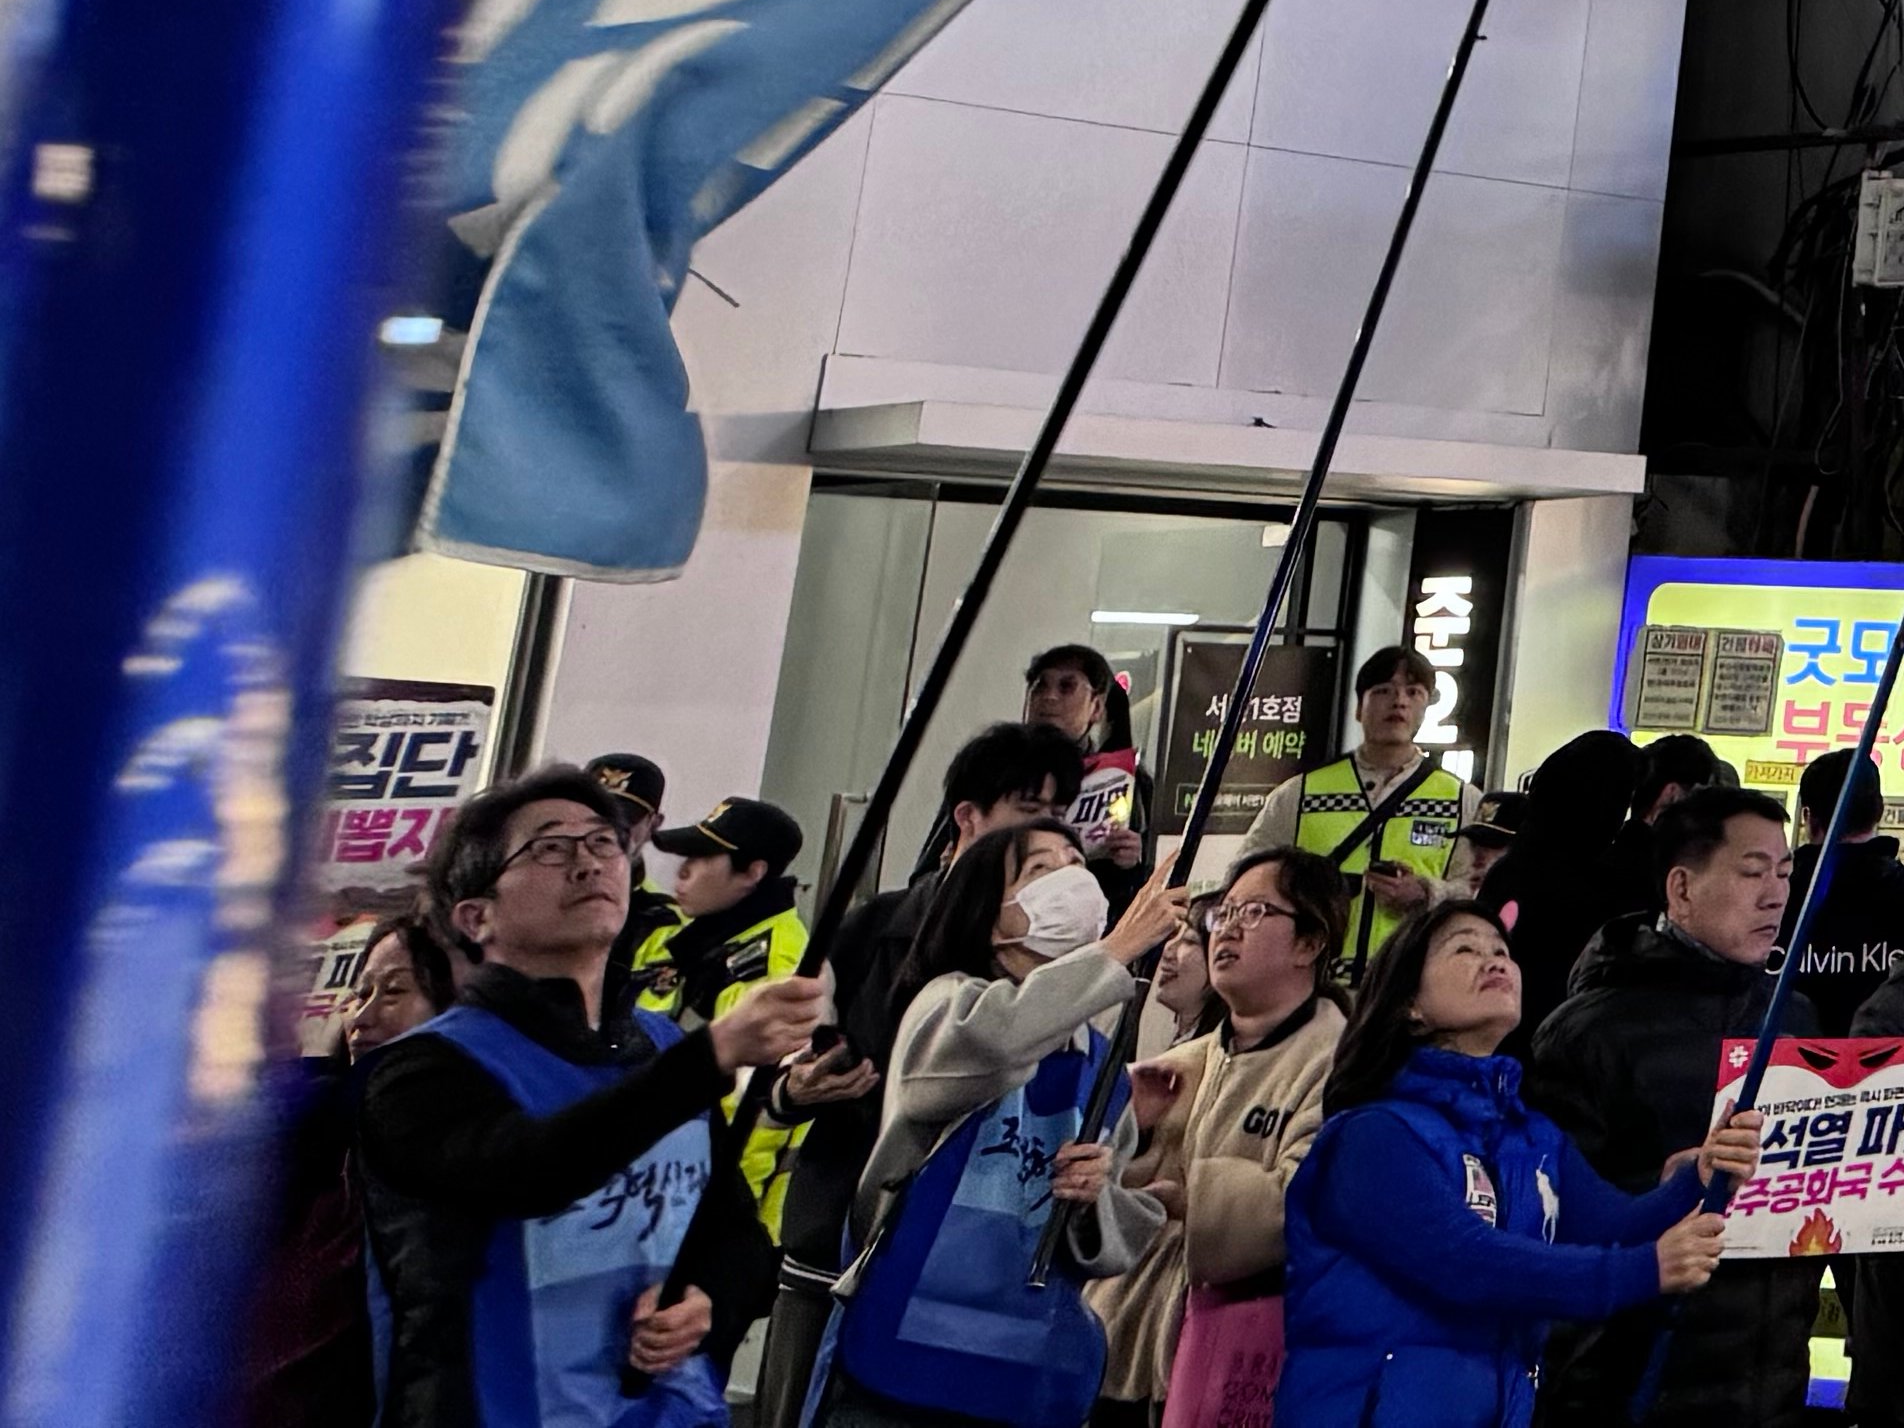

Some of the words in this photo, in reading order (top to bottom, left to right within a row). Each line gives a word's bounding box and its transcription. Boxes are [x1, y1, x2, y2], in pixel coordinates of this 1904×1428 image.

[1205, 694, 1302, 725] 서1호점
[1192, 728, 1257, 761] 네버
[1261, 728, 1307, 760] 예약
[1764, 943, 1858, 977] Clvin
[1761, 1109, 1850, 1171] 석열
